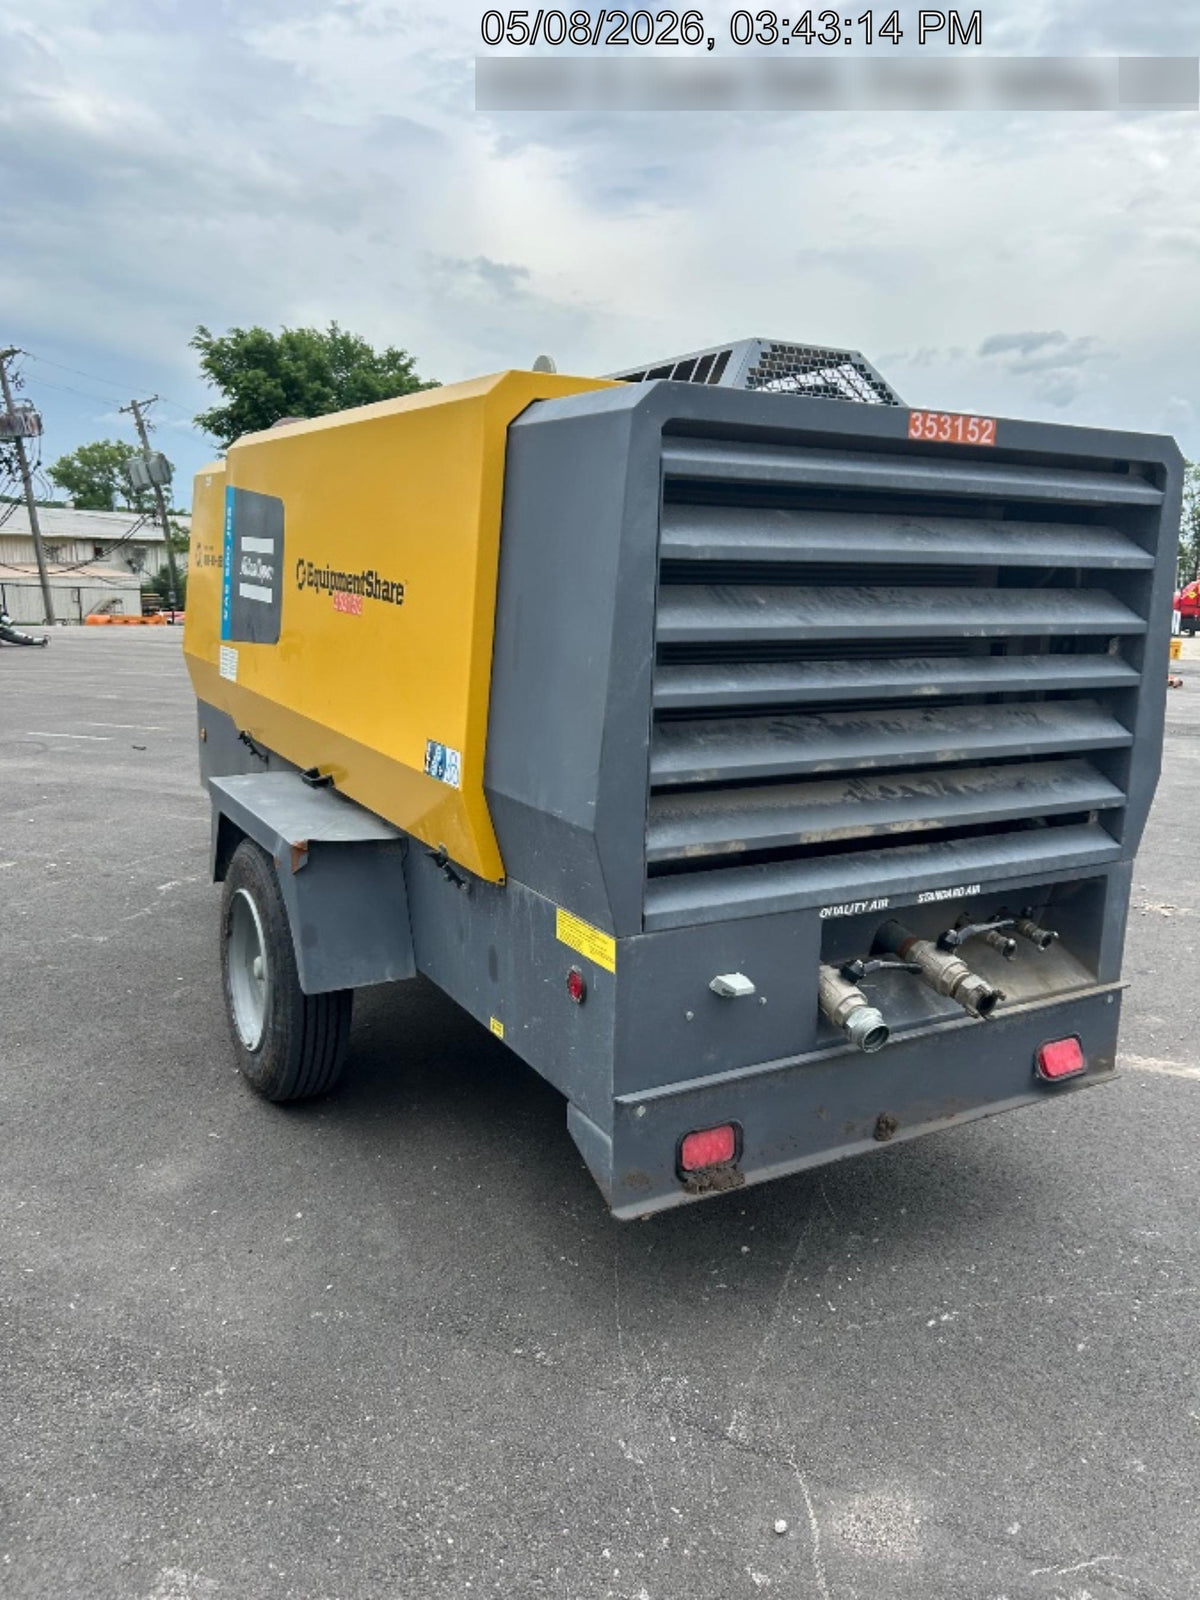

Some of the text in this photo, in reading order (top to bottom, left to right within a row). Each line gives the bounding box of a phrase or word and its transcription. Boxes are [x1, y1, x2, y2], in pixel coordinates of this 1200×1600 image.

[908, 411, 994, 444] 353152
[306, 561, 405, 606] EquipmentShare
[917, 884, 982, 904] STANDARD AIR
[818, 898, 890, 918] QUALITY AIR
